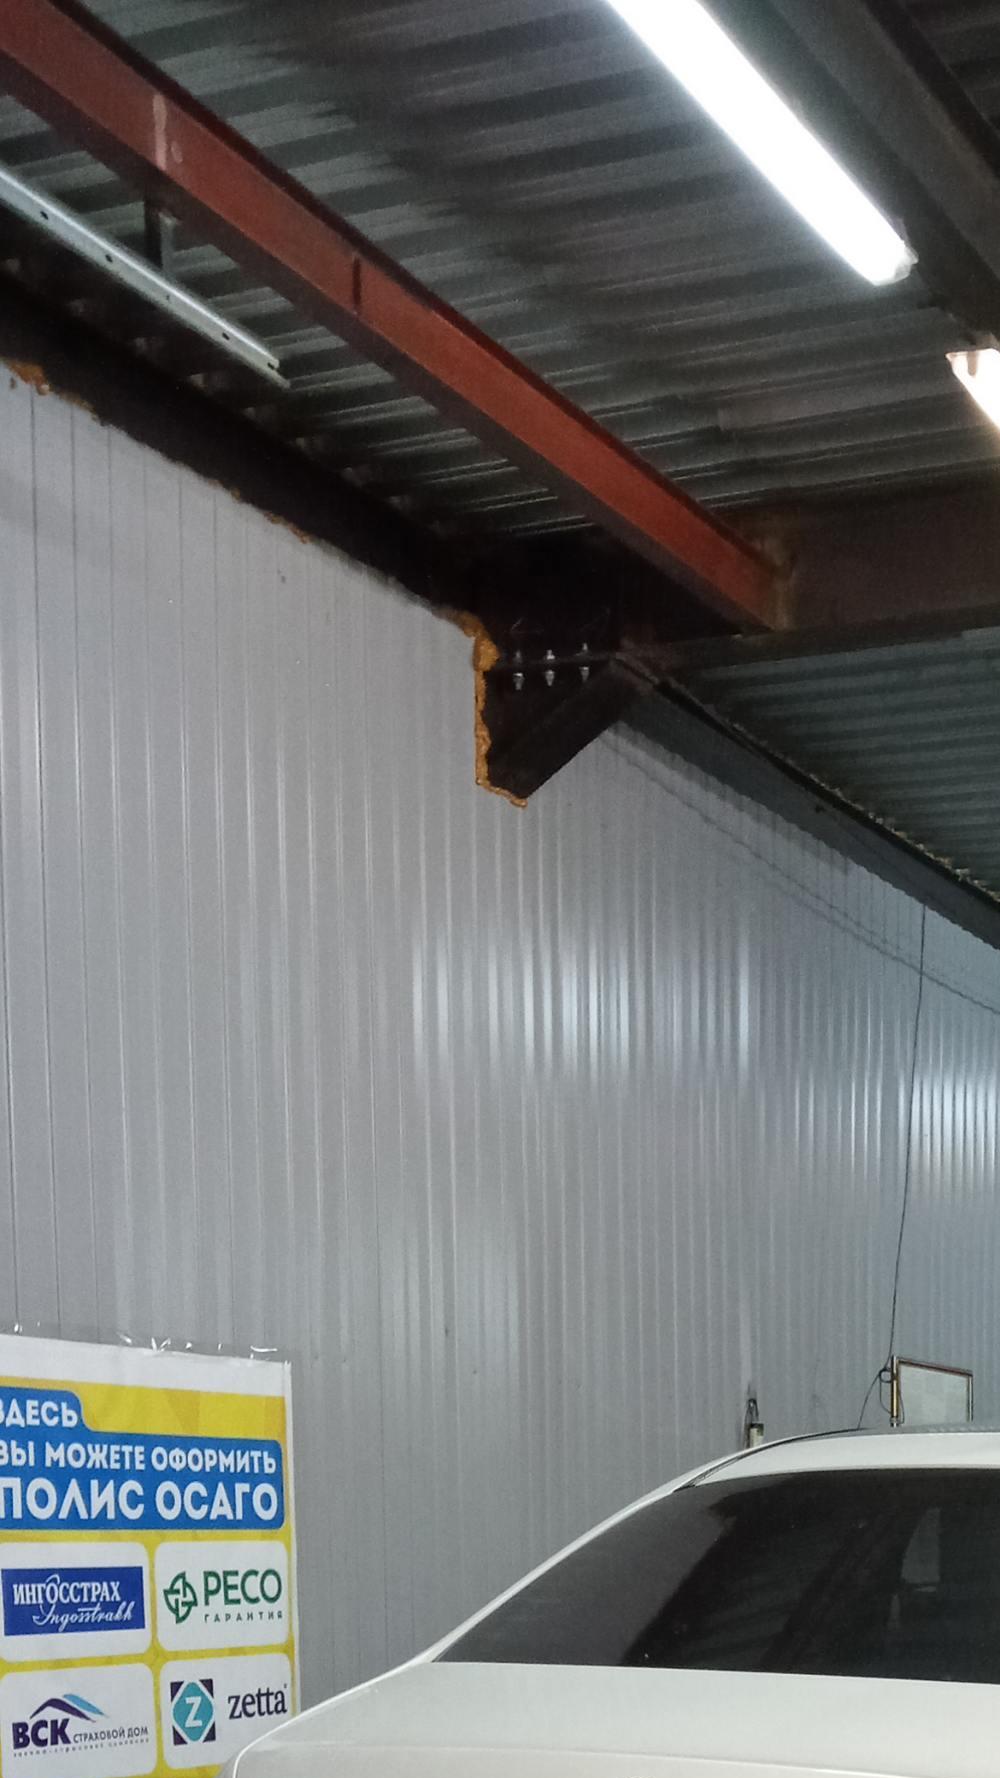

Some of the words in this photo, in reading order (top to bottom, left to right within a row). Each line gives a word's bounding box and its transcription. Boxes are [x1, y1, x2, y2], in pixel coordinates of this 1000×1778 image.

[45, 1442, 146, 1471] МОЖЕТЕ
[151, 1446, 277, 1474] ОФОРМИТЬ
[0, 1477, 145, 1521] ПОЛИС
[155, 1480, 278, 1521] ОСАГО
[12, 1574, 122, 1606] ИНГОССТРАХ
[203, 1568, 282, 1606] РЕСО
[204, 1611, 283, 1623] ГАРАНТИЯ
[227, 1687, 288, 1720] zetta
[12, 1718, 72, 1750] ВСК
[73, 1728, 125, 1744] СТРАХОВОЙ
[127, 1726, 149, 1738] ДОМ
